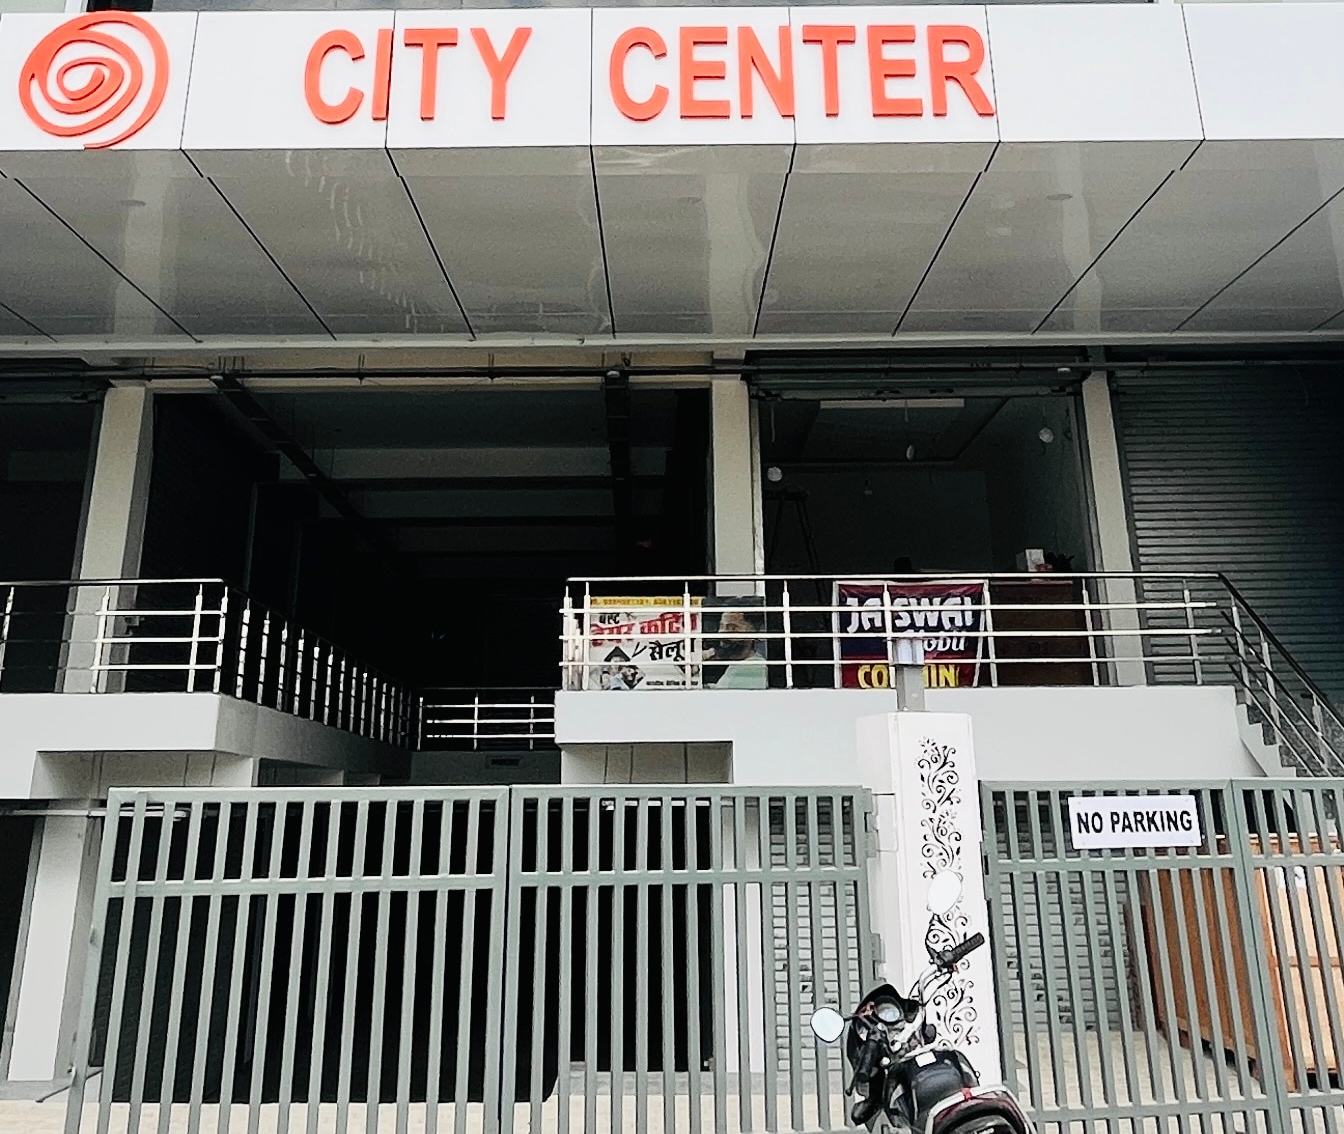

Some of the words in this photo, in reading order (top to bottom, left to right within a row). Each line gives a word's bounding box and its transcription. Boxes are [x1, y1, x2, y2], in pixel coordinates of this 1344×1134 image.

[304, 27, 533, 124] CITY
[609, 24, 996, 122] CENTER
[1076, 812, 1103, 834] NO
[1110, 810, 1193, 833] PARKING
